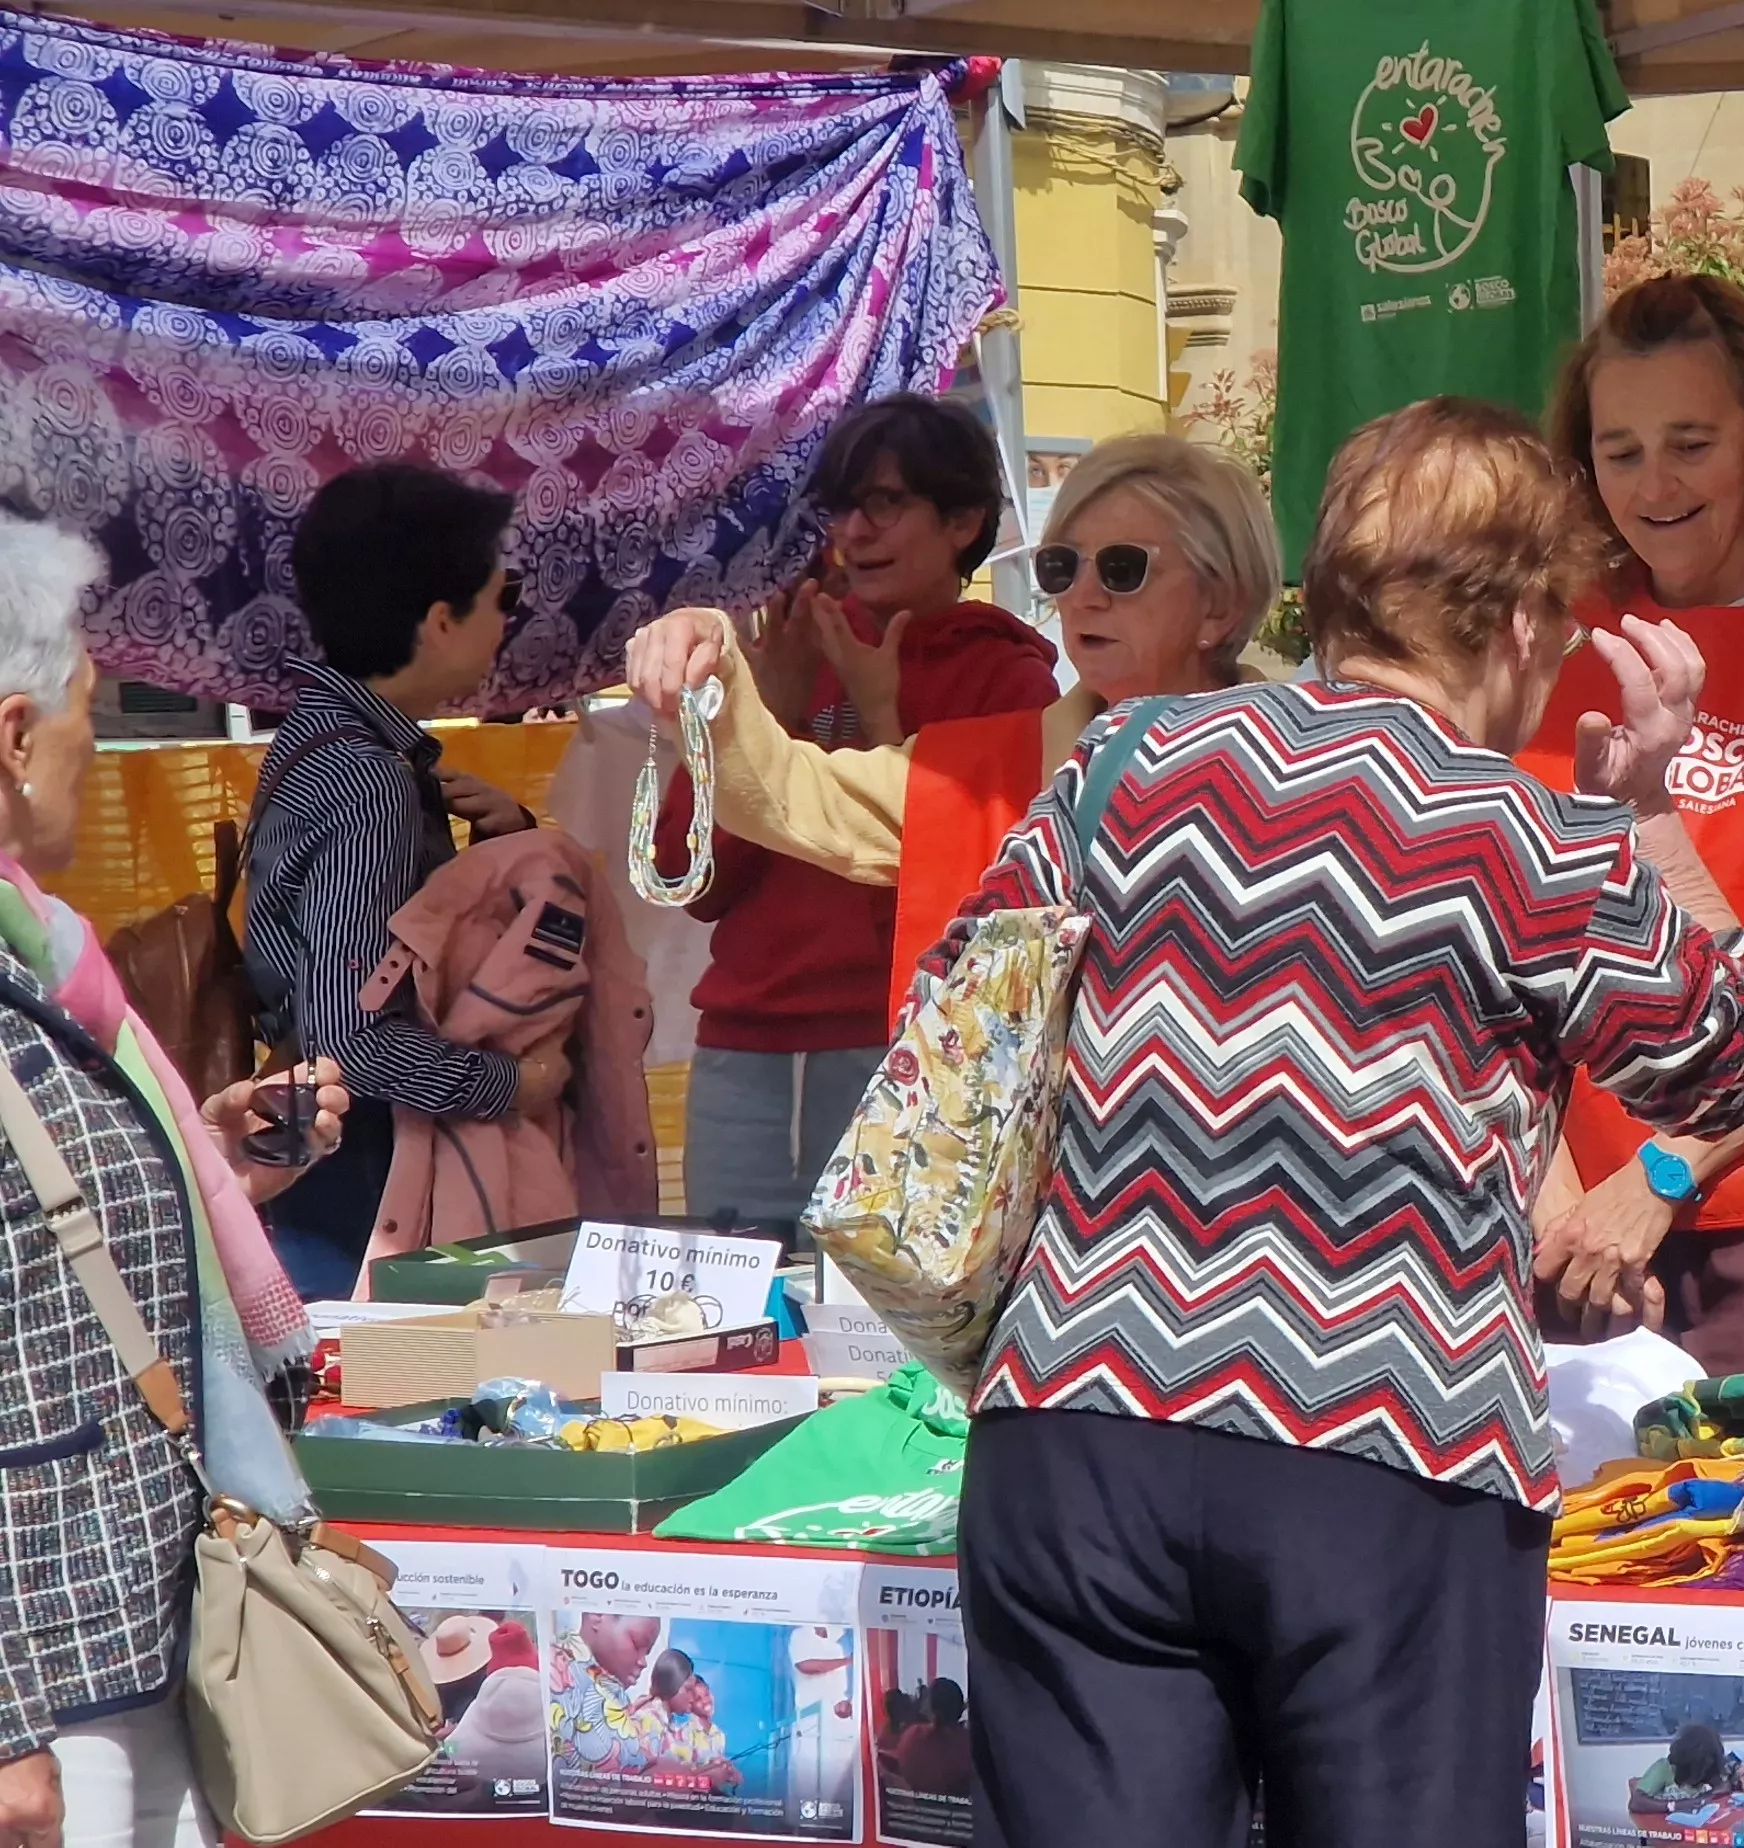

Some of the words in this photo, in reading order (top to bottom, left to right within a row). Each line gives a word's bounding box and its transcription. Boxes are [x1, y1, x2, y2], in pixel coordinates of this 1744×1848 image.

[1343, 196, 1409, 231] Bosco
[1355, 221, 1427, 274] Global
[586, 1232, 681, 1261] Donativo
[685, 1246, 760, 1269] mínimo
[647, 1269, 675, 1292] 10
[681, 1273, 696, 1294] €
[627, 1390, 709, 1412] Donativo
[714, 1393, 788, 1414] mínimo:
[433, 1573, 485, 1586] sostenible
[561, 1569, 620, 1589] TOGO
[622, 1580, 632, 1592] la
[634, 1582, 691, 1596] educación
[694, 1587, 706, 1597] es
[709, 1585, 720, 1598] la
[722, 1588, 779, 1602] esperanza
[1568, 1622, 1682, 1648] SENEGAL
[1684, 1635, 1734, 1651] jóvenes
